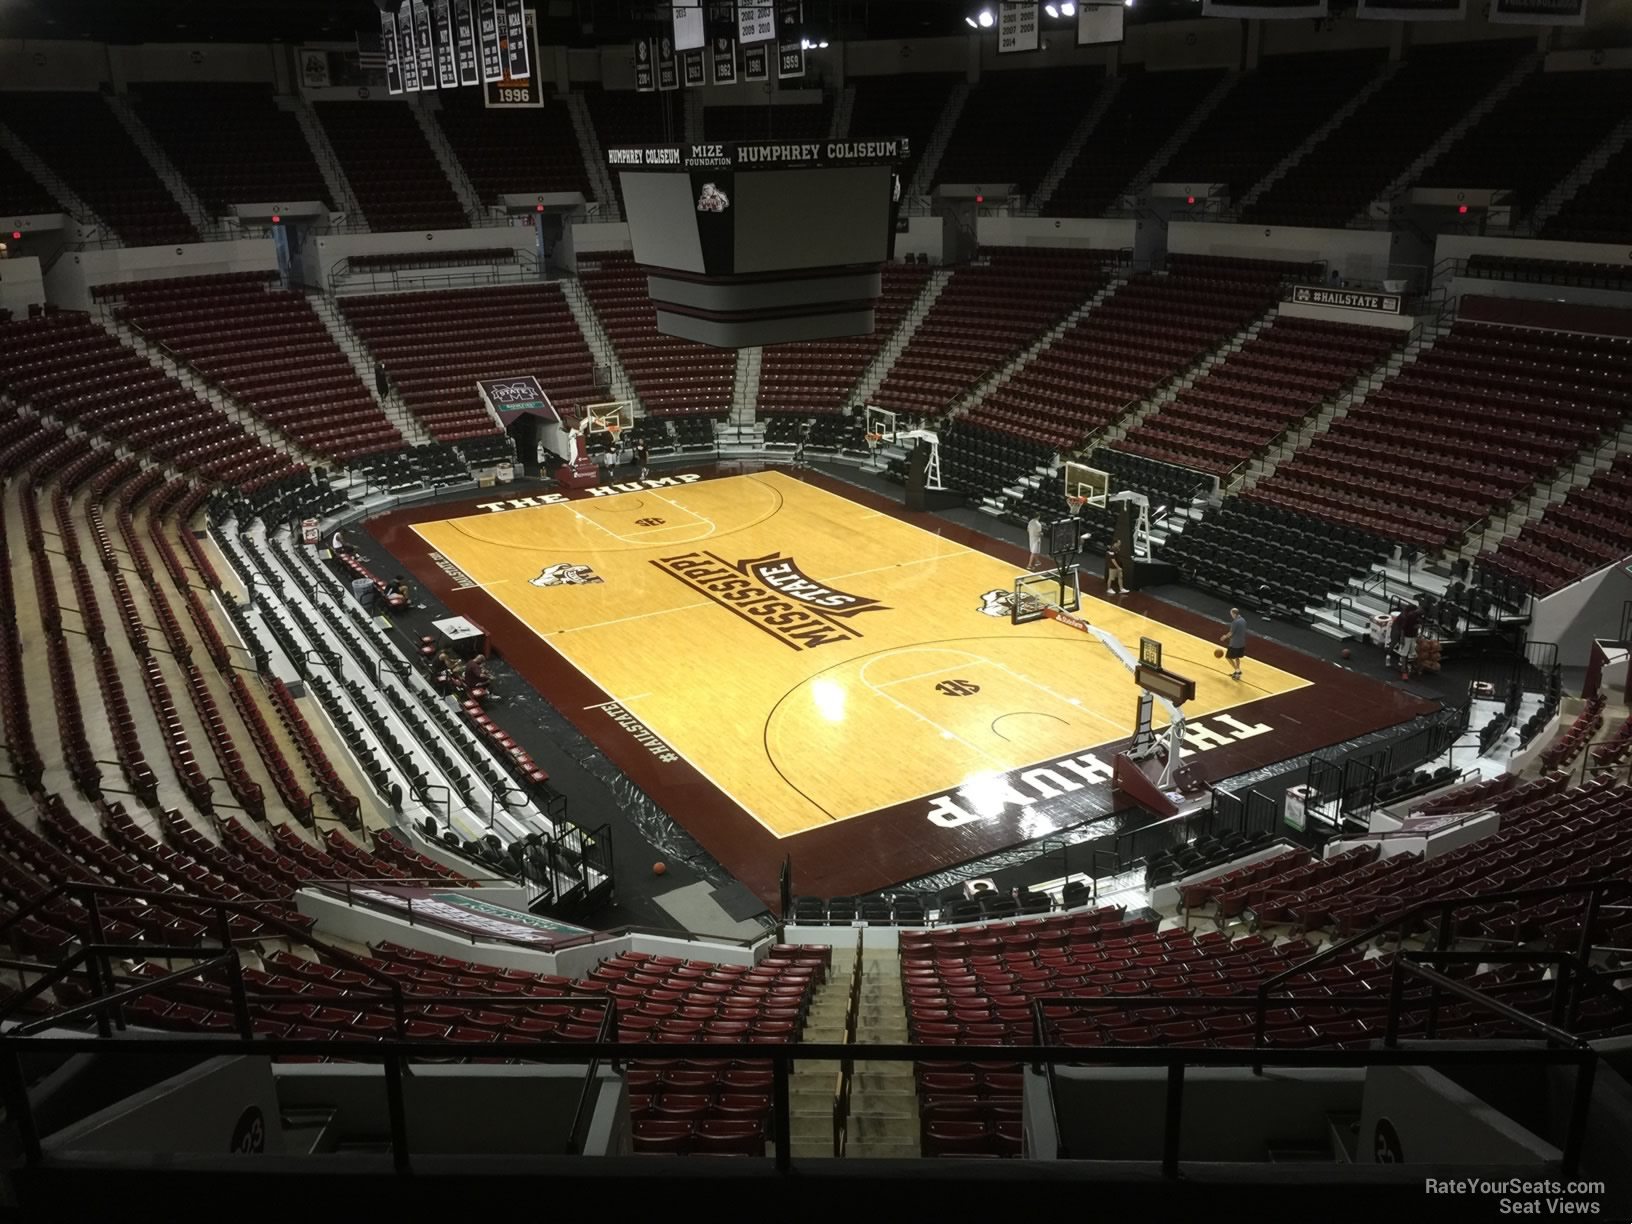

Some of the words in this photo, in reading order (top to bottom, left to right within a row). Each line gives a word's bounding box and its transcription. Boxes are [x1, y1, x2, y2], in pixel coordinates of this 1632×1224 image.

[1002, 38, 1016, 48] 2014
[783, 55, 799, 70] 1959
[499, 89, 529, 102] 1996
[608, 149, 643, 164] HUMPHREY
[645, 148, 681, 164] COLISEUM
[692, 145, 724, 158] MIZE
[737, 144, 820, 163] HUMPHREY
[827, 141, 897, 159] COLISEUM
[685, 157, 731, 167] FOUNDATION
[1313, 291, 1378, 308] #HAILSTATE
[476, 493, 570, 513] THE
[585, 473, 702, 497] HUMP
[759, 562, 856, 607] STATE
[660, 552, 852, 649] MISSISSIPPI
[936, 679, 980, 697] SEC
[600, 703, 679, 763] #HAILSTATE
